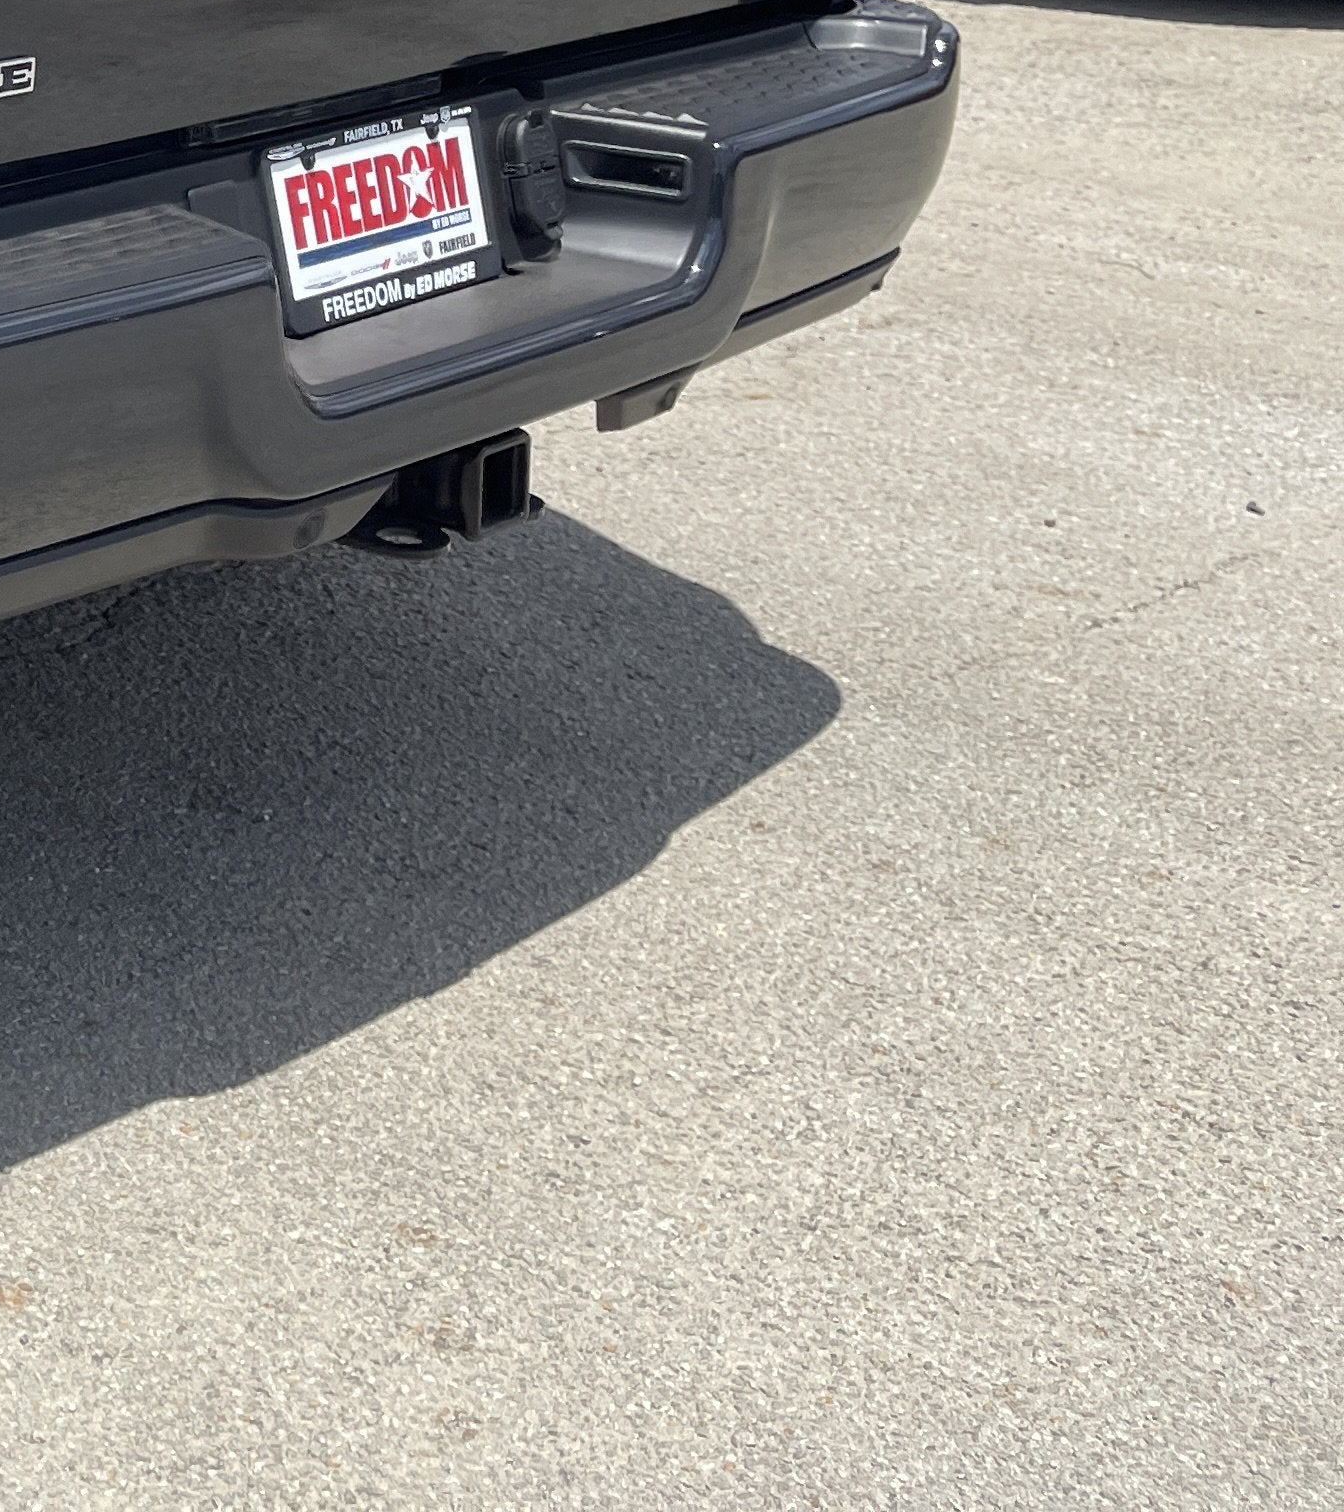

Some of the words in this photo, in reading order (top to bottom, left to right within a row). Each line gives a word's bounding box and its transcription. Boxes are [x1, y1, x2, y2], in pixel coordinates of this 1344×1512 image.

[390, 118, 404, 132] TX
[284, 137, 469, 250] FREEDOM
[439, 232, 476, 255] FAIRFIELD
[322, 278, 402, 322] FREEDOM
[415, 274, 434, 296] ED
[433, 260, 476, 290] MORSE
